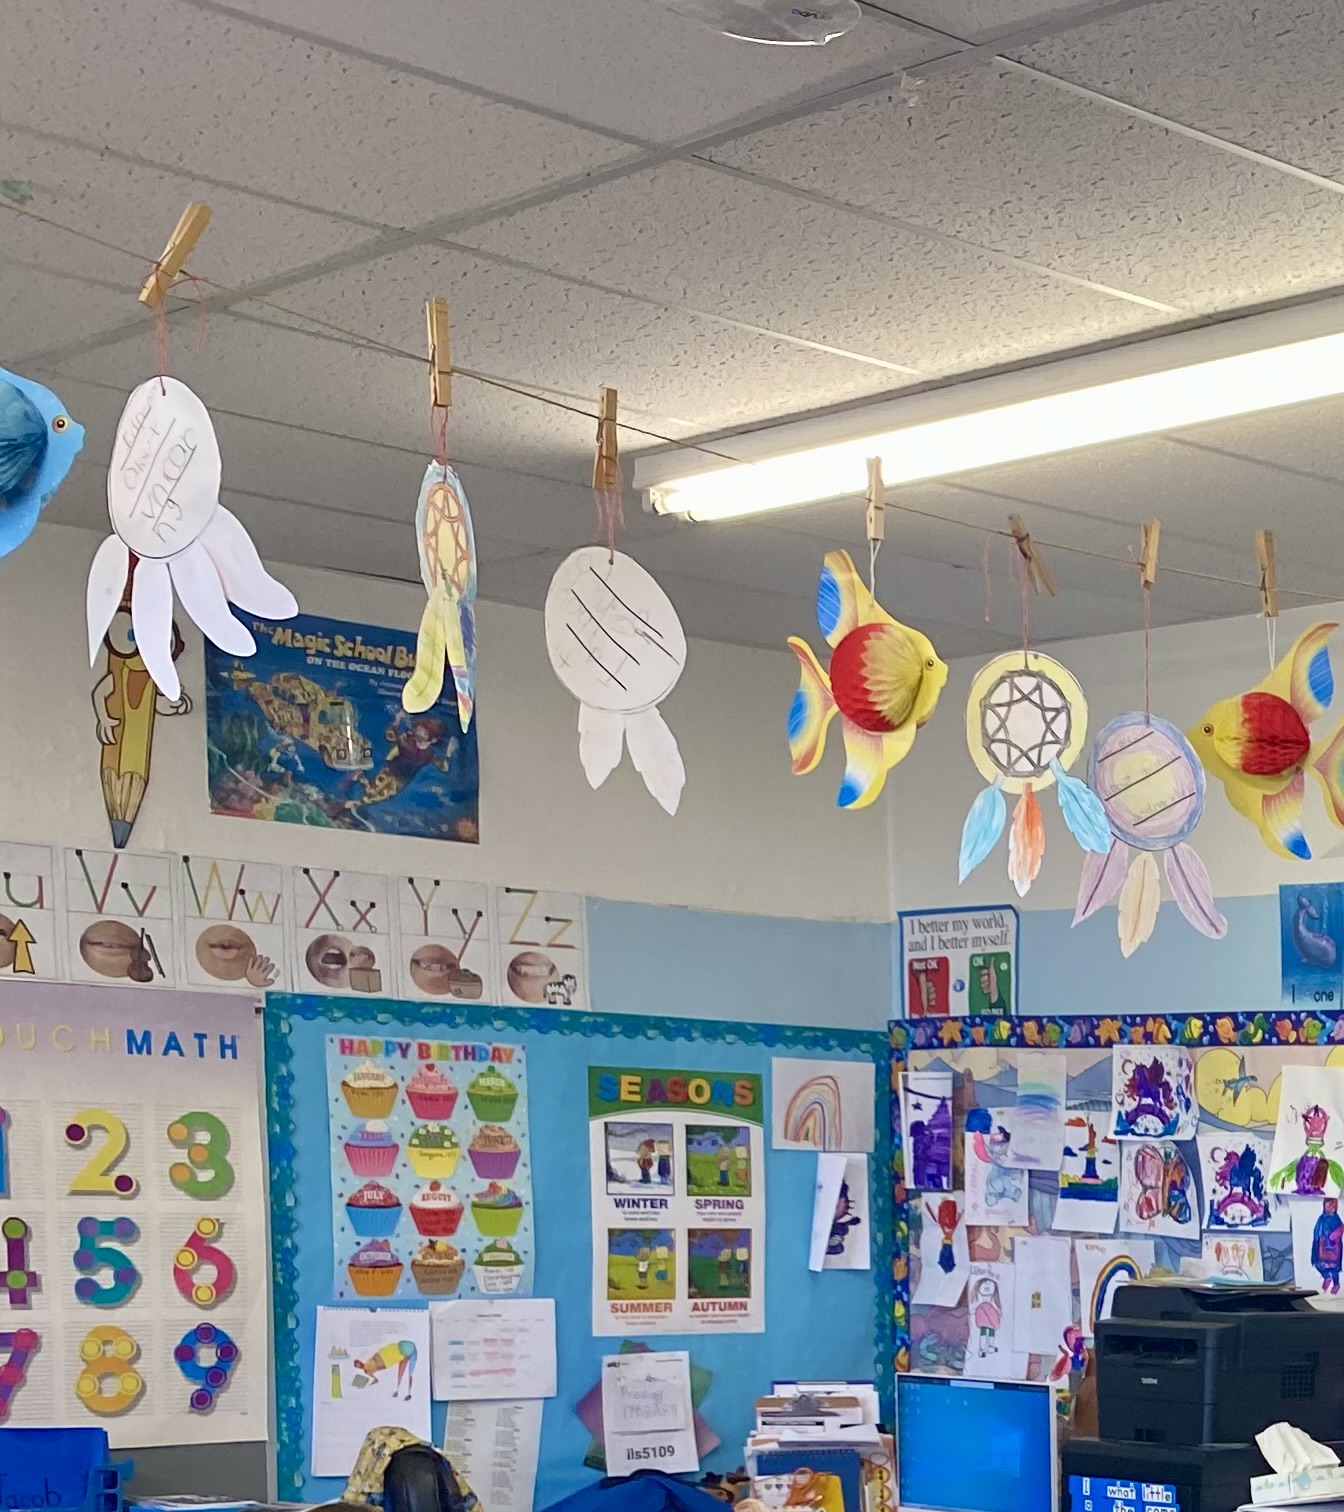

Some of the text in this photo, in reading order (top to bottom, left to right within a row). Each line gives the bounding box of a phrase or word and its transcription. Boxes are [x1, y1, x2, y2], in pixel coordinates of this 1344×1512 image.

[272, 628, 393, 664] Magic School
[1313, 991, 1334, 1002] one
[339, 1039, 515, 1063] HAPPY BIRTHDAY
[597, 1074, 754, 1106] SEASONS
[614, 1198, 668, 1210] WINTER
[695, 1200, 744, 1211] SPRING
[611, 1303, 673, 1313] SUMMER
[692, 1301, 748, 1312] AUTUMN
[1109, 1487, 1135, 1497] what
[1143, 1485, 1170, 1501] little
